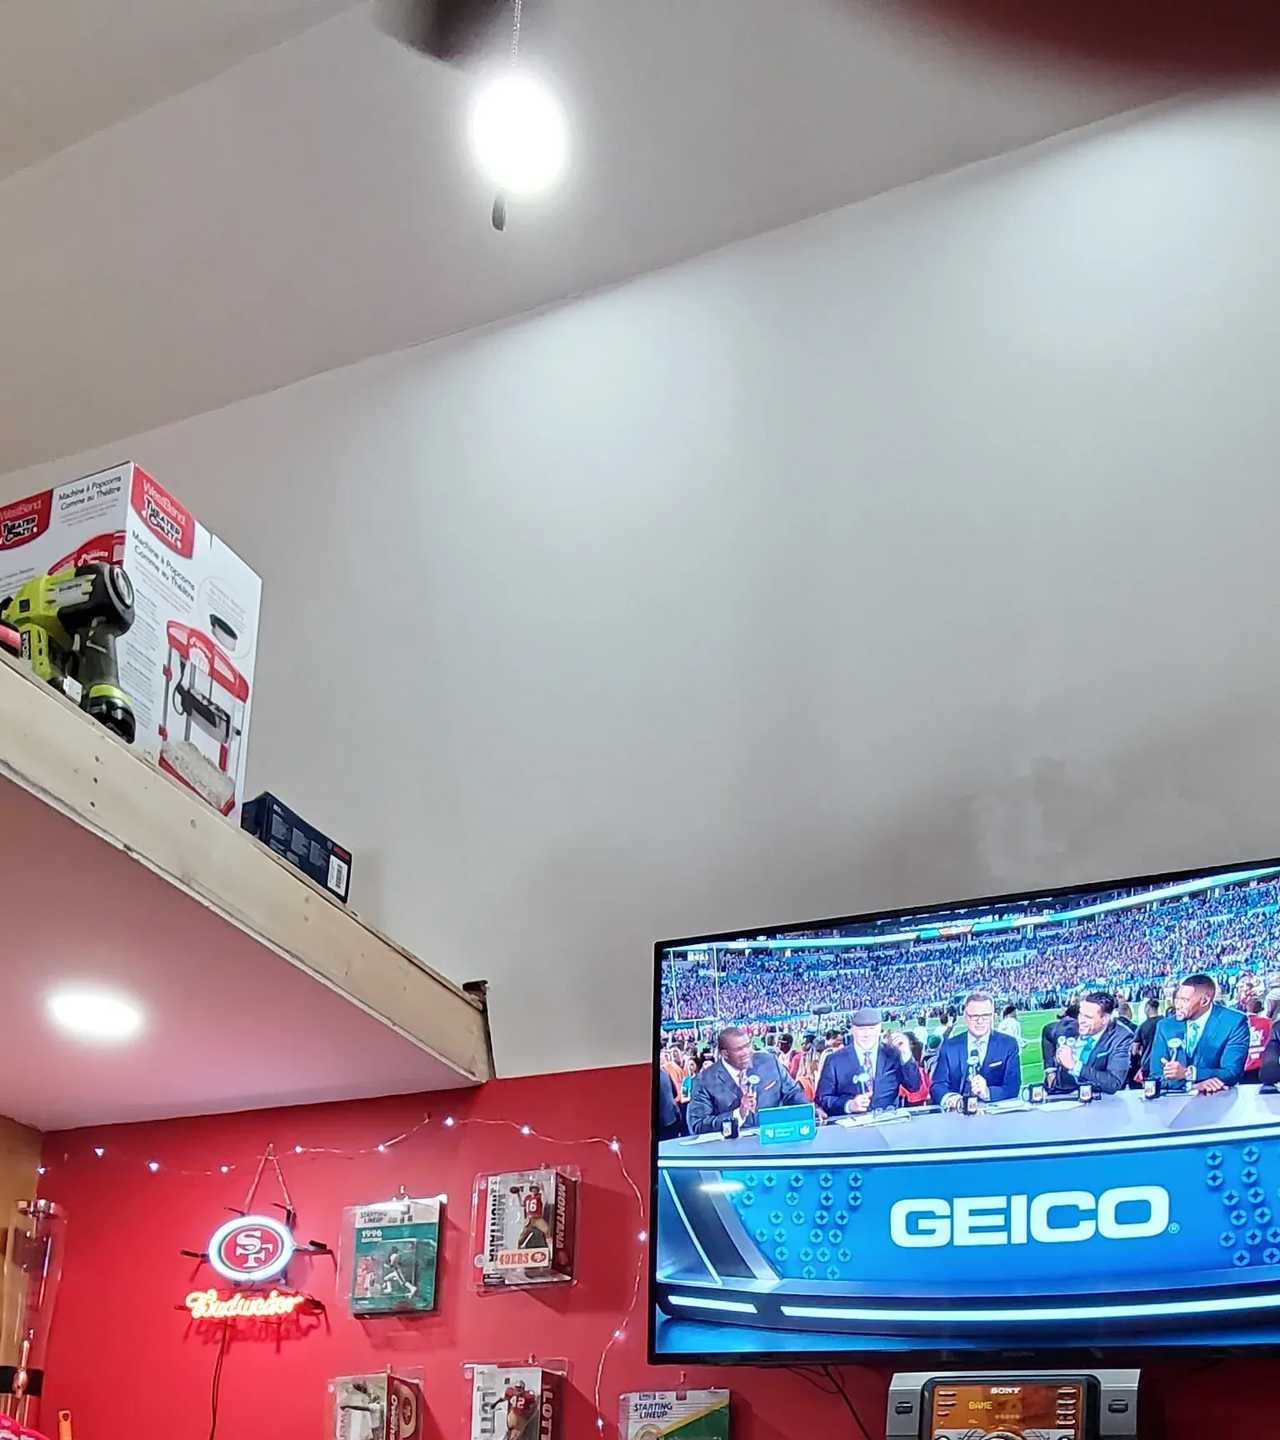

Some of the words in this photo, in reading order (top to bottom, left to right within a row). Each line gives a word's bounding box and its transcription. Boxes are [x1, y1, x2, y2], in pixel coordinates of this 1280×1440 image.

[889, 1185, 1170, 1249] GEICO
[990, 1387, 1022, 1395] SONY
[633, 1402, 673, 1412] STARTING
[639, 1410, 669, 1420] LINEUP
